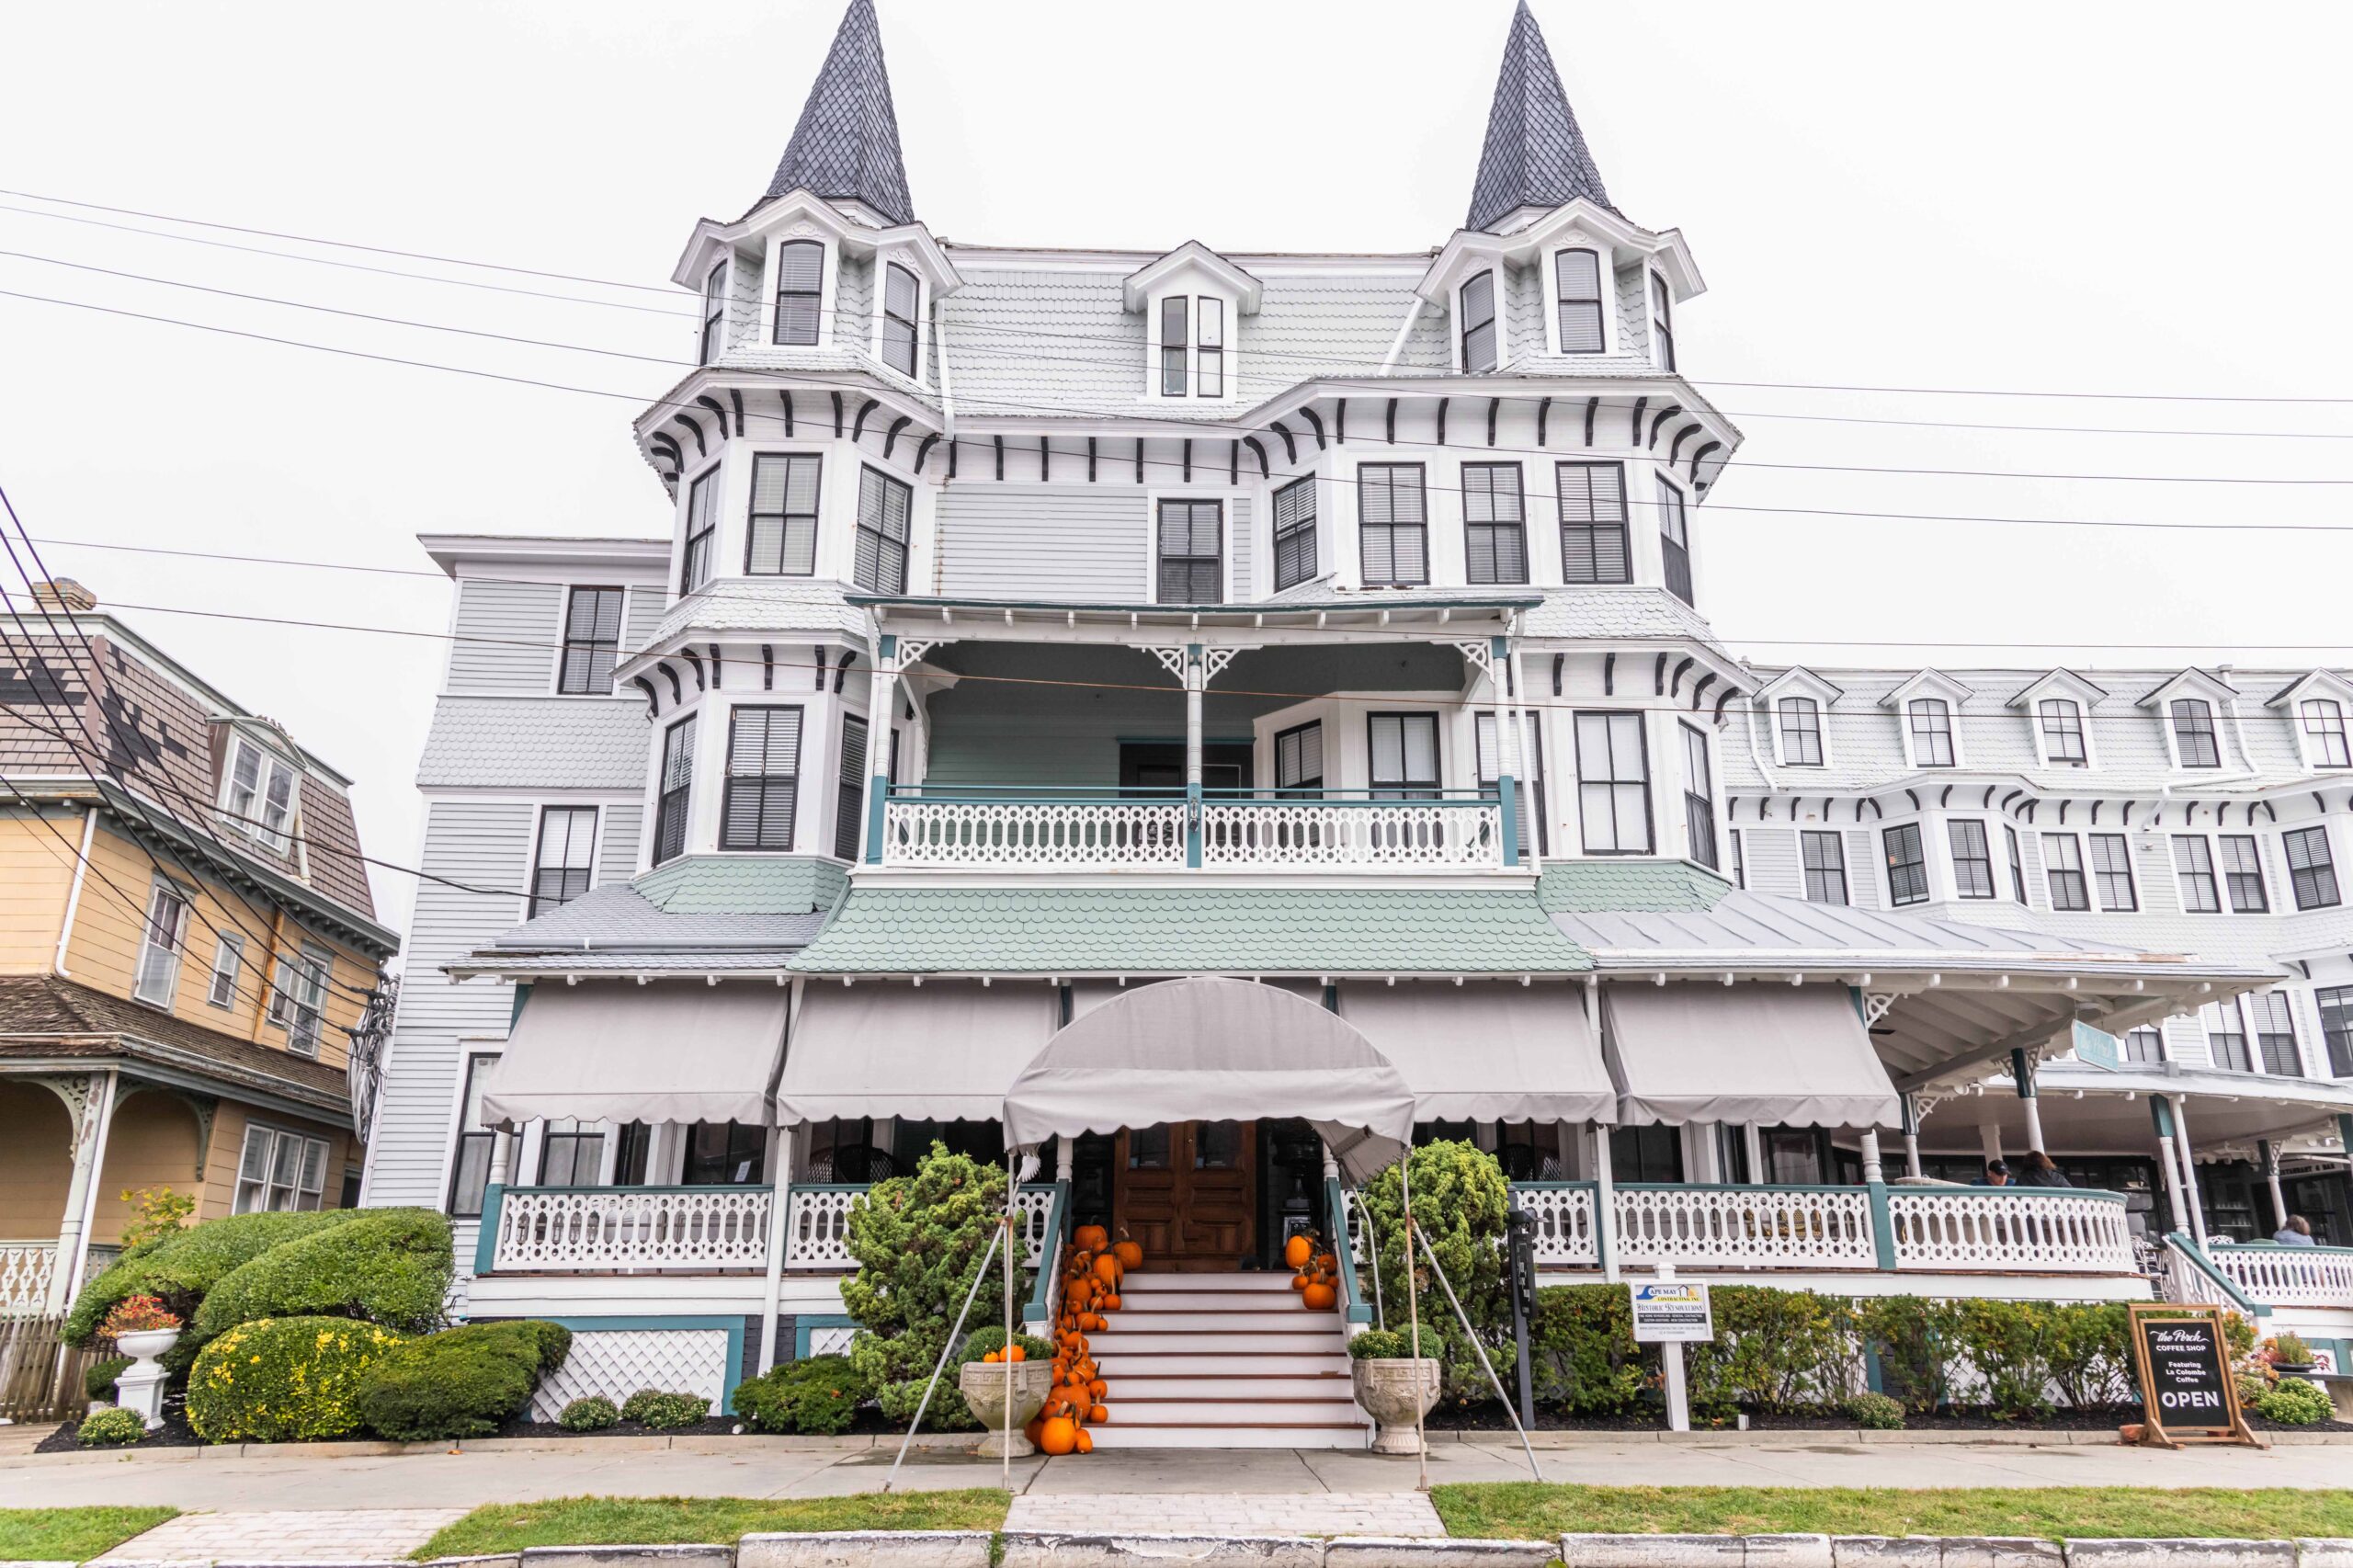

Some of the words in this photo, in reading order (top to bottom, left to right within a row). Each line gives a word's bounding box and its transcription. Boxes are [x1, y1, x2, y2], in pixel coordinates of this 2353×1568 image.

[1636, 1302, 1664, 1312] HISTORIC
[1665, 1302, 1703, 1312] RENOVATIONS
[2173, 1329, 2211, 1342] Porch
[2161, 1391, 2220, 1408] OPEN
